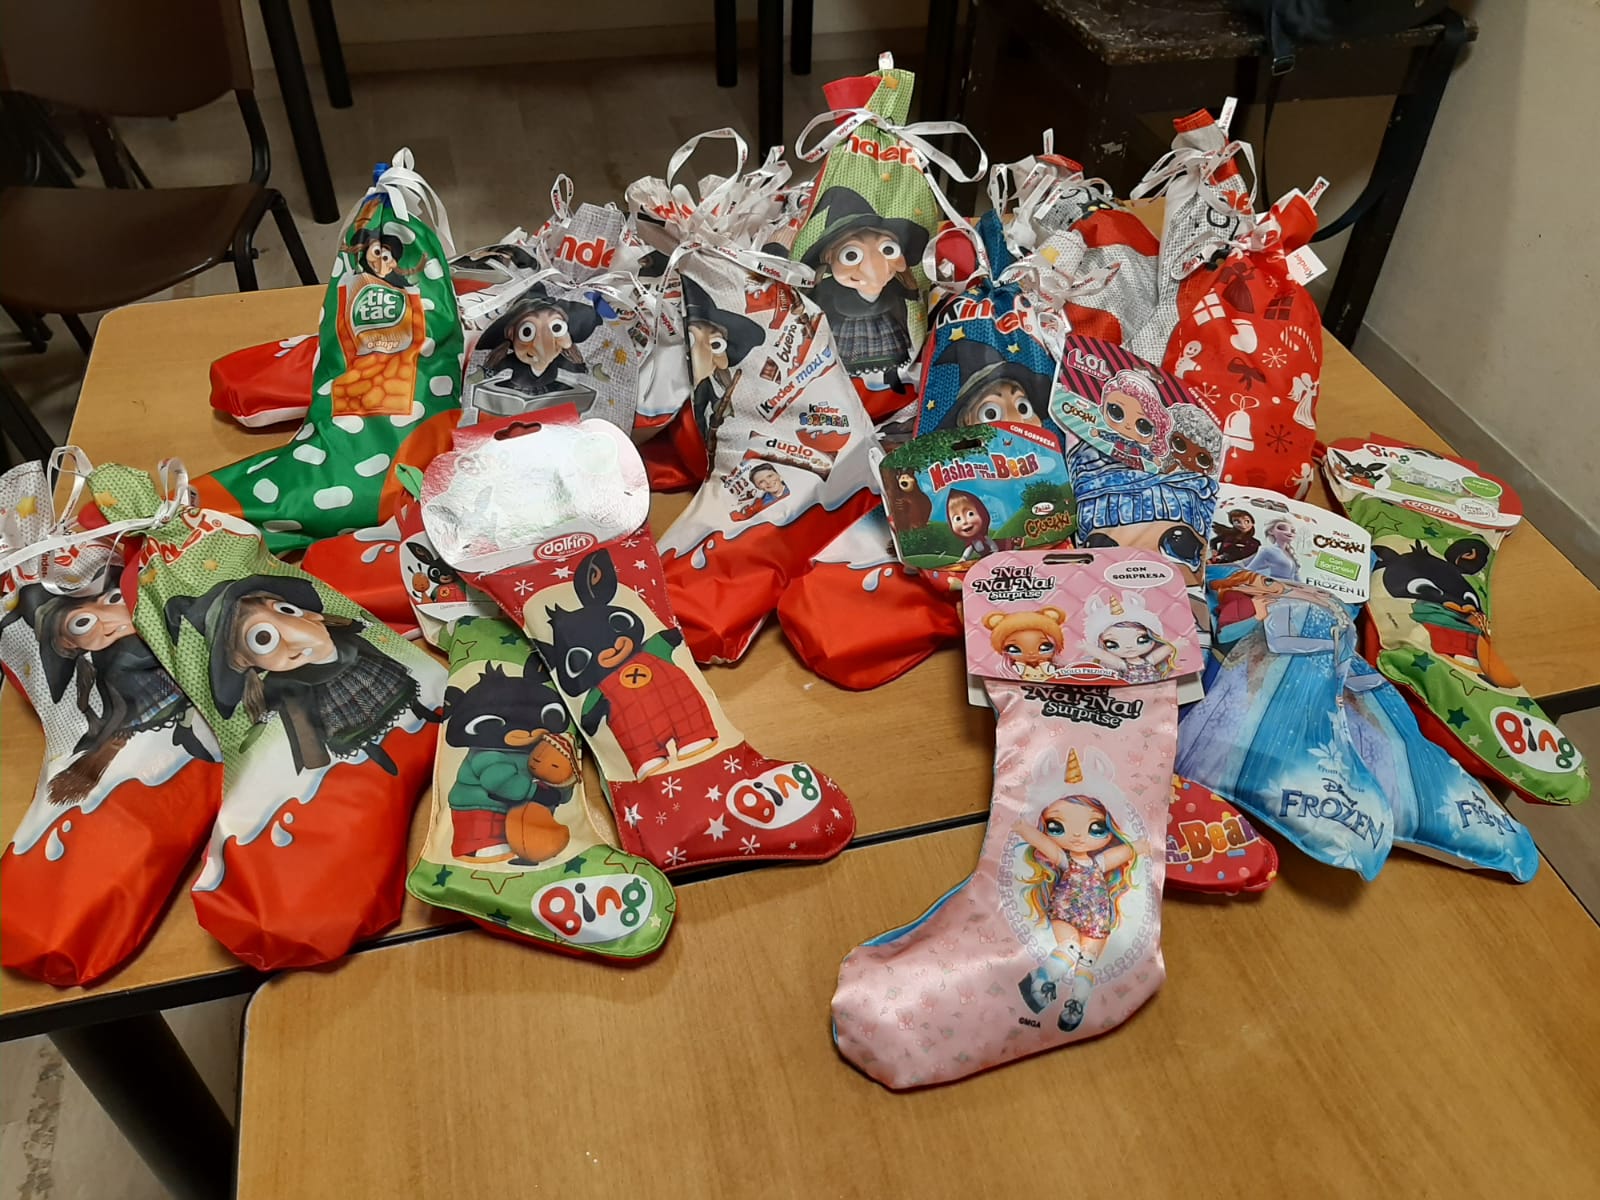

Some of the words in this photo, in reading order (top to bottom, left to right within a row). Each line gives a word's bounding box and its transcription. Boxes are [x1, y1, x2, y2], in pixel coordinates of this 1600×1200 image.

[366, 288, 400, 306] tic
[359, 304, 396, 321] tac
[367, 340, 400, 351] oange
[776, 323, 798, 363] bueno
[795, 352, 825, 384] maxi
[765, 438, 814, 458] duplo
[1009, 424, 1024, 435] CON
[1023, 430, 1056, 448] SORPRESA
[929, 459, 976, 492] Masha
[543, 536, 587, 555] dolfin
[991, 565, 1034, 579] Na!
[989, 590, 1042, 601] Surprise
[1305, 577, 1355, 594] FROZEN
[1045, 701, 1121, 727] Surprise
[1495, 711, 1576, 769] Bing
[733, 763, 818, 824] Bing
[1278, 788, 1385, 849] FROZEN
[538, 877, 648, 938] Bing
